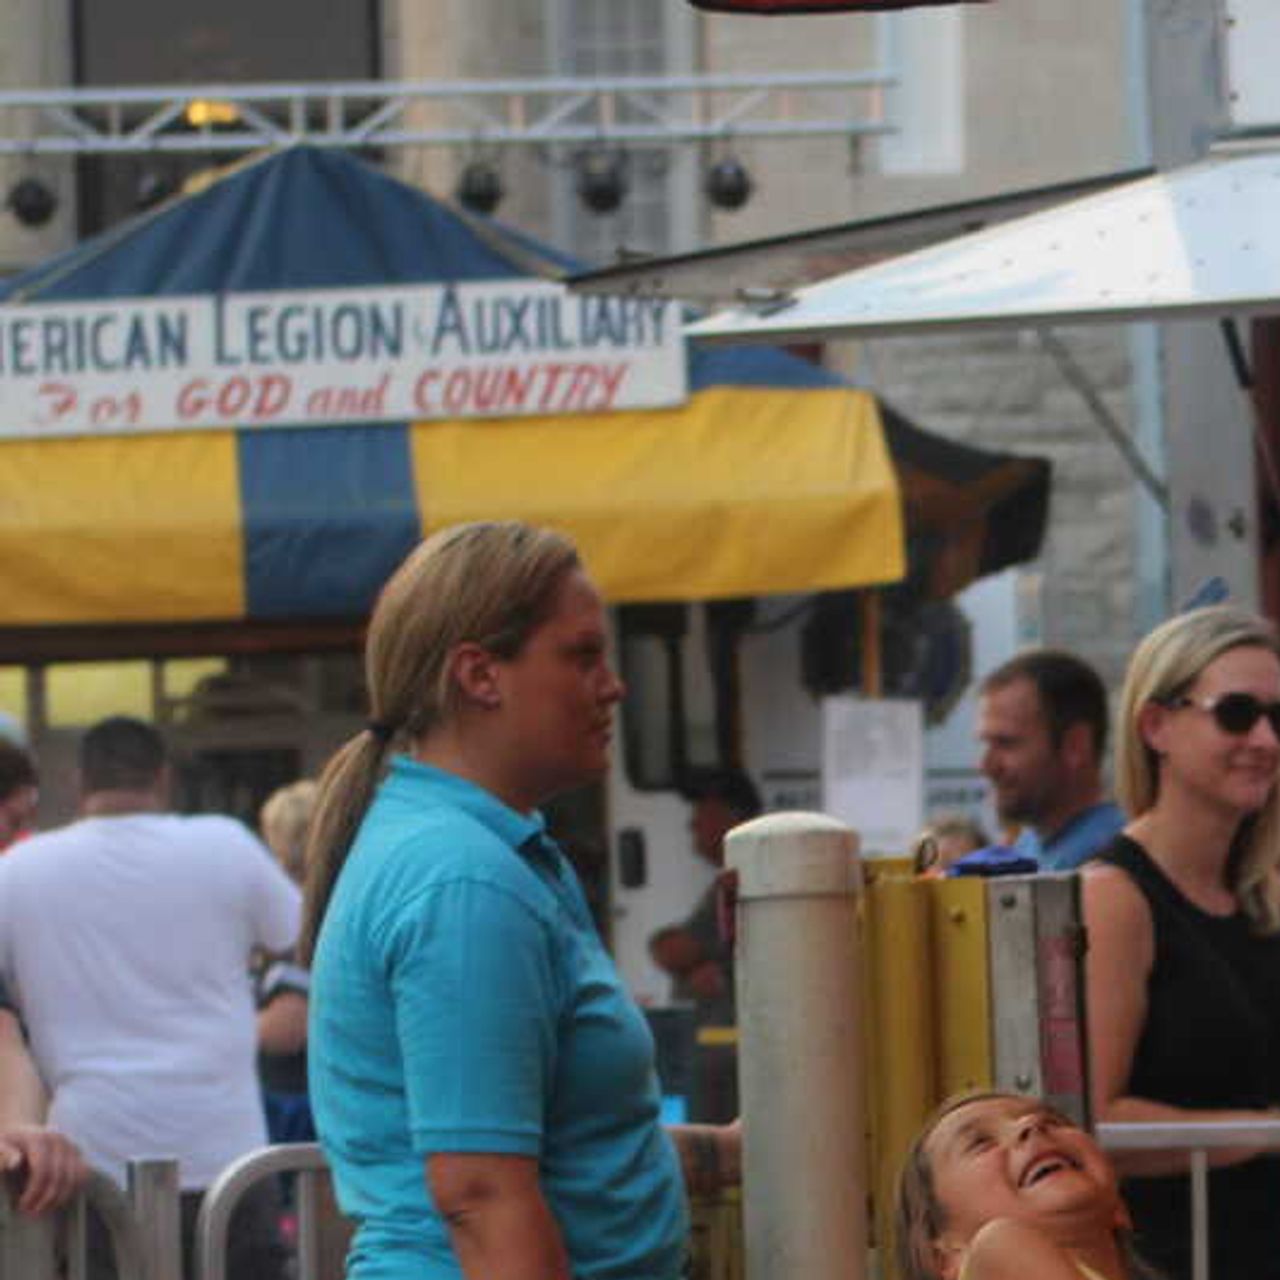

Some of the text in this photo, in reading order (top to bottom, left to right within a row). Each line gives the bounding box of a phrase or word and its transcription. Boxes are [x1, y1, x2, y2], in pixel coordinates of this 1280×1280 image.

[0, 312, 188, 376] ERICAN
[214, 292, 402, 366] LEGION
[176, 374, 292, 418] GOD
[306, 370, 390, 416] and
[413, 362, 628, 414] COUNTRY
